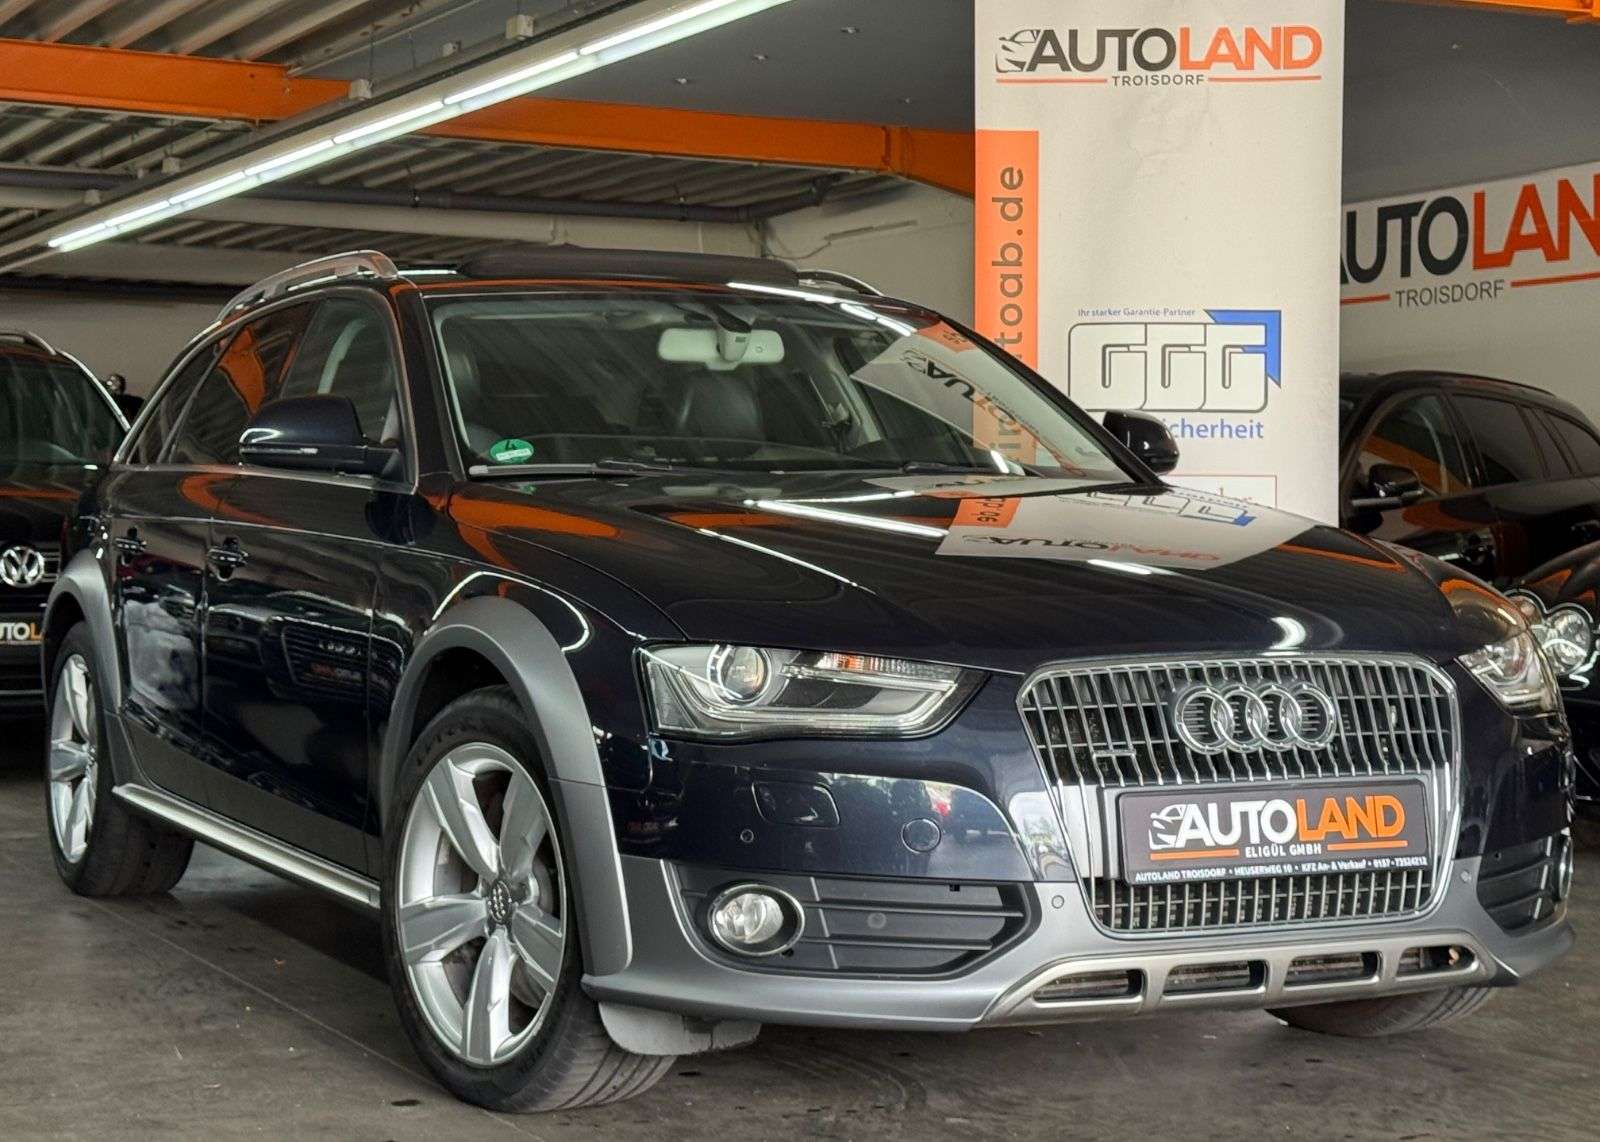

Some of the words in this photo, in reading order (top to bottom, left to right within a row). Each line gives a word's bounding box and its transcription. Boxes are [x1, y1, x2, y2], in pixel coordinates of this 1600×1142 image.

[1025, 26, 1323, 73] AUTOLAND
[1111, 74, 1205, 88] TROISDORF
[1340, 173, 1600, 285] UTOLAN
[991, 166, 1023, 358] toab.de
[1395, 279, 1505, 309] TROISDORF
[1078, 308, 1090, 317] Ihr
[1092, 308, 1121, 317] starker
[1174, 795, 1406, 849] AUTOLAND
[1245, 844, 1287, 858] ELIGÜL
[1289, 843, 1322, 857] GMBH
[1135, 870, 1181, 882] AUTOLAND
[1182, 867, 1227, 880] TROISDORF
